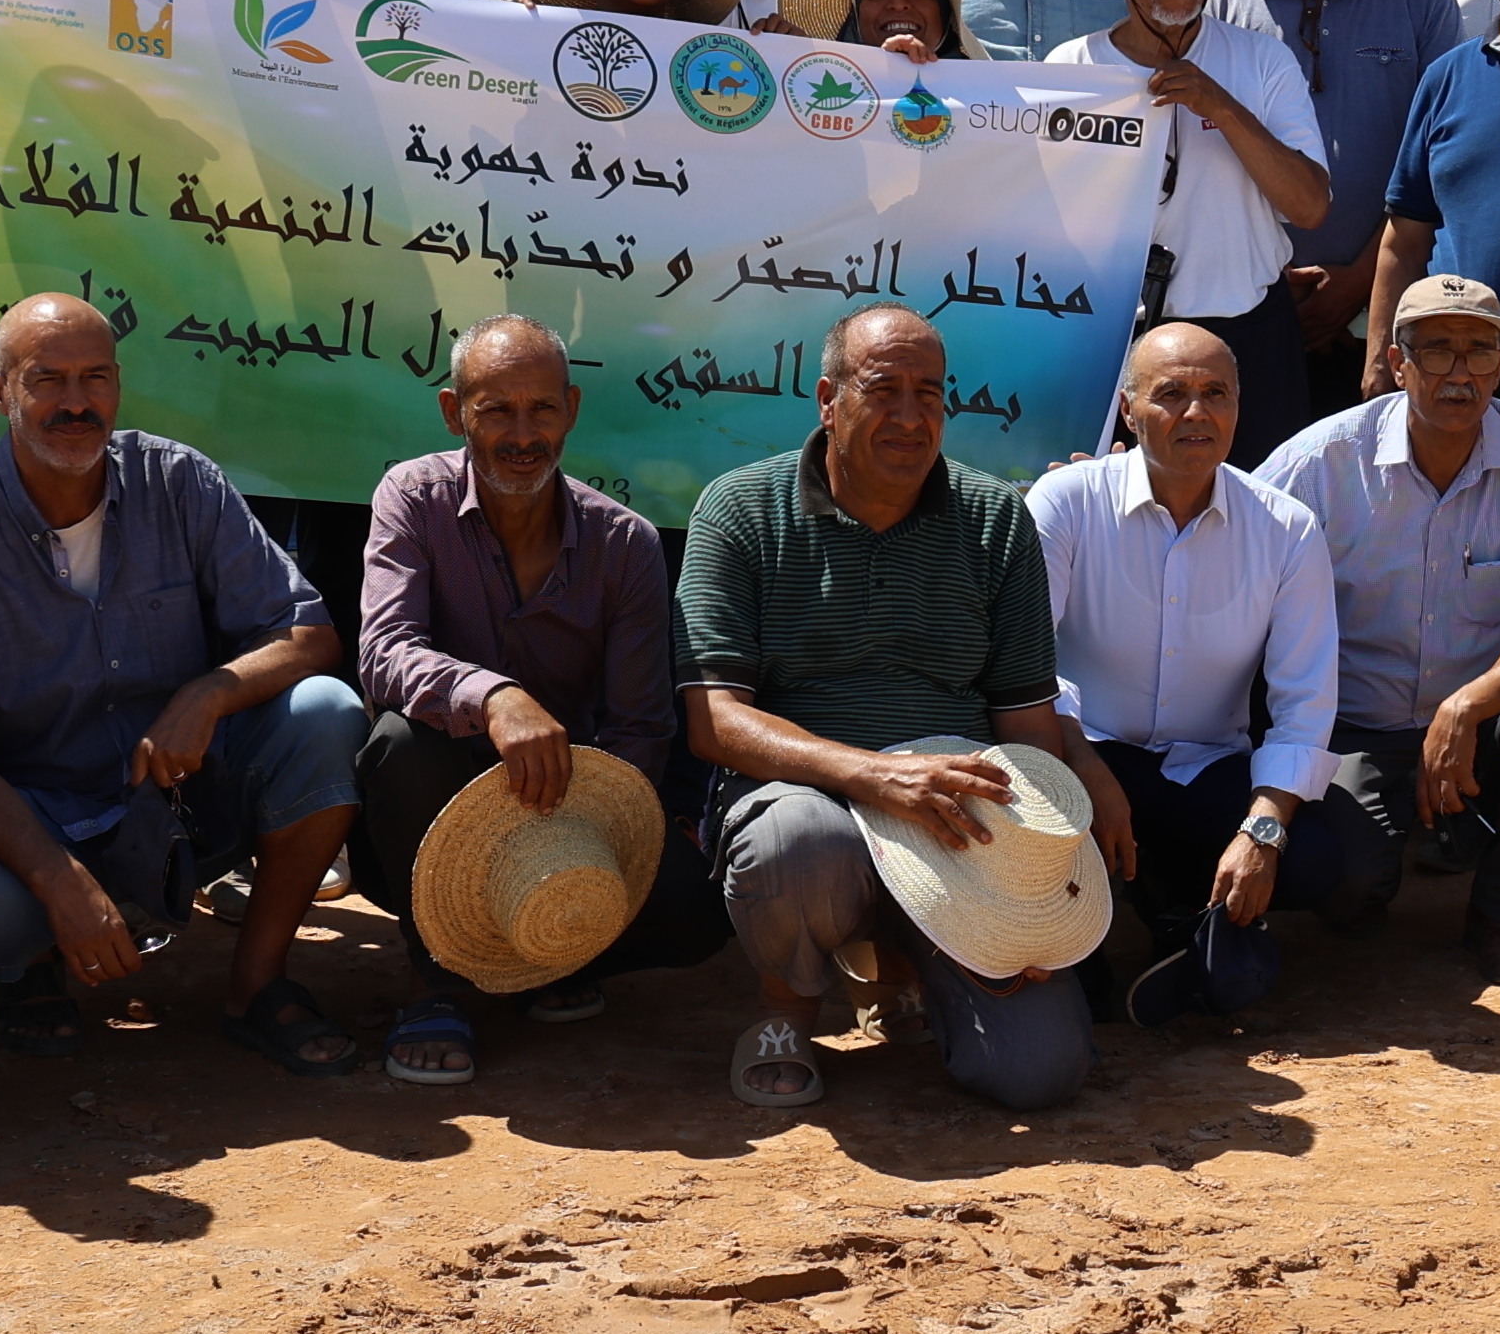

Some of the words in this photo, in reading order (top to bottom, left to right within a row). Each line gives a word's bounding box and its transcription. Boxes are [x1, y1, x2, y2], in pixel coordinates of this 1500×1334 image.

[16, 2, 54, 13] Recherche
[66, 9, 76, 17] de
[116, 32, 164, 57] OSS
[468, 70, 538, 97] Desert
[676, 86, 697, 115] Institut
[700, 113, 713, 125] des
[751, 95, 769, 118] Arides
[811, 113, 854, 132] CBBC
[1076, 115, 1141, 145] one
[405, 123, 555, 186] جهوية
[570, 141, 689, 199] ندوة
[169, 172, 382, 247] التنمية
[655, 247, 694, 297] و
[927, 246, 1094, 319] مخاطر
[163, 296, 381, 368] الحبيب
[635, 339, 809, 411] السقي
